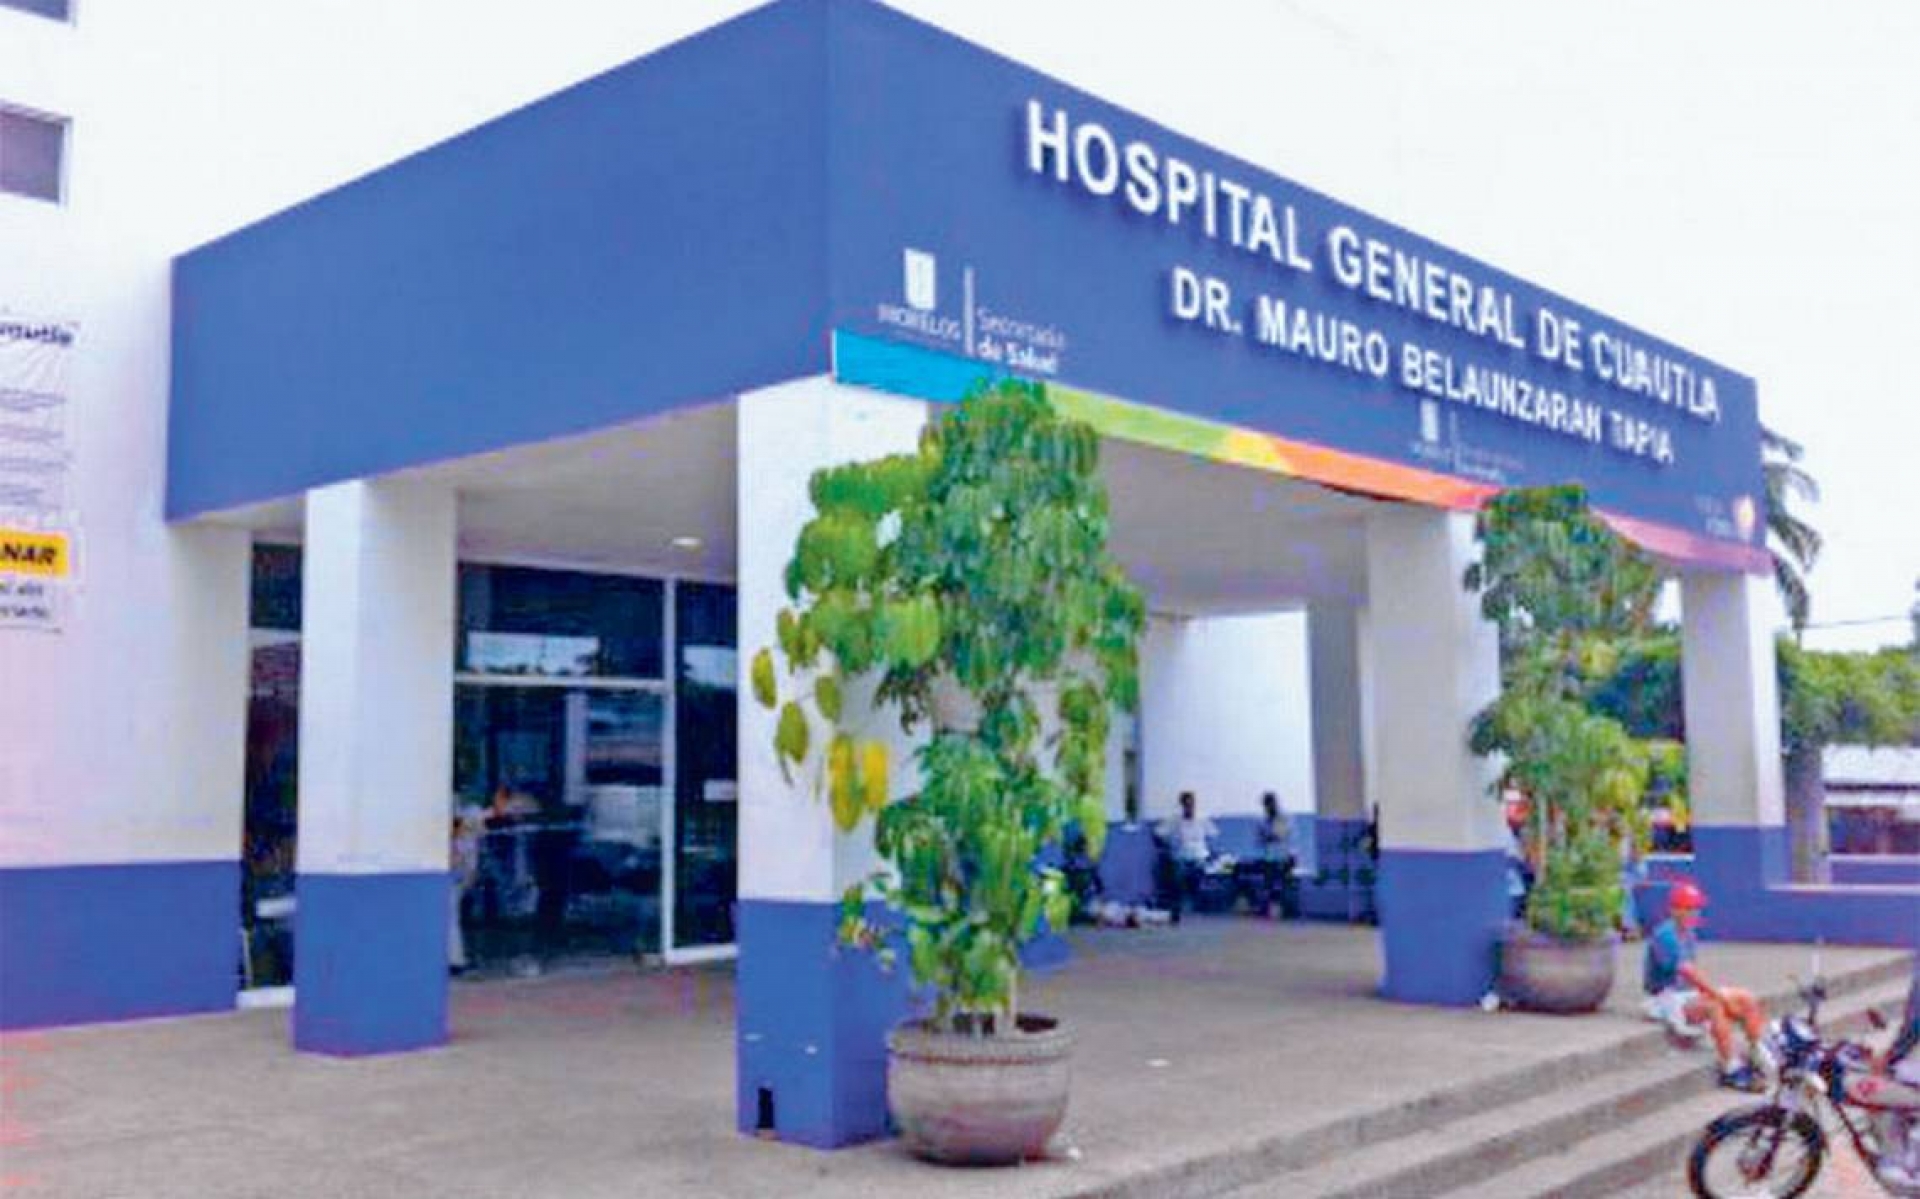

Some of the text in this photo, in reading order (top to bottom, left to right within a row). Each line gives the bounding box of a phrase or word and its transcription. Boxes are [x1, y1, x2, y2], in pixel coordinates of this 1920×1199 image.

[1028, 99, 1721, 423] HOSPITAL GENERAL DE CUAUTLA
[1173, 266, 1242, 335] DR.
[1257, 294, 1389, 377] MAURO
[1402, 343, 1602, 444] BELAUNZARAN
[1609, 409, 1674, 464] TAPIA
